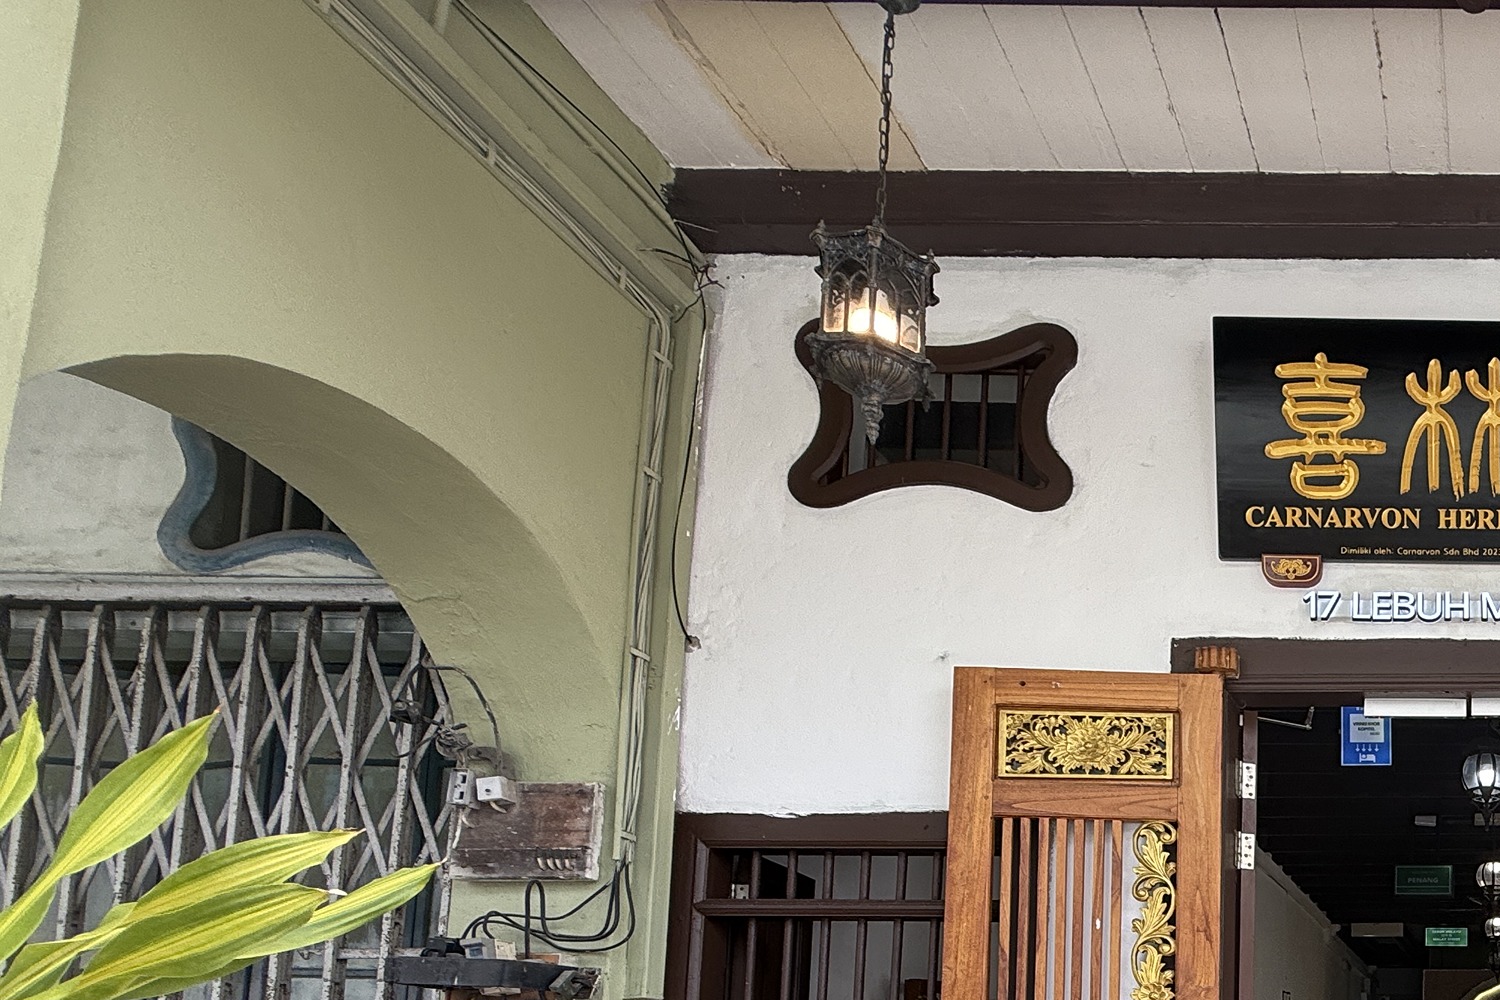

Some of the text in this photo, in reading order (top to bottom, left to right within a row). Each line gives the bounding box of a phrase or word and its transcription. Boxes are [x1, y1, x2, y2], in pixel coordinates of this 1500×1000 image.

[1245, 506, 1421, 530] CARNARVON
[1340, 546, 1371, 556] Dimiliki
[1397, 547, 1441, 556] Carnarvon
[1444, 547, 1460, 556] Sdn
[1463, 547, 1480, 556] Bhd
[1303, 590, 1341, 622] 17
[1352, 591, 1470, 623] LEBUH
